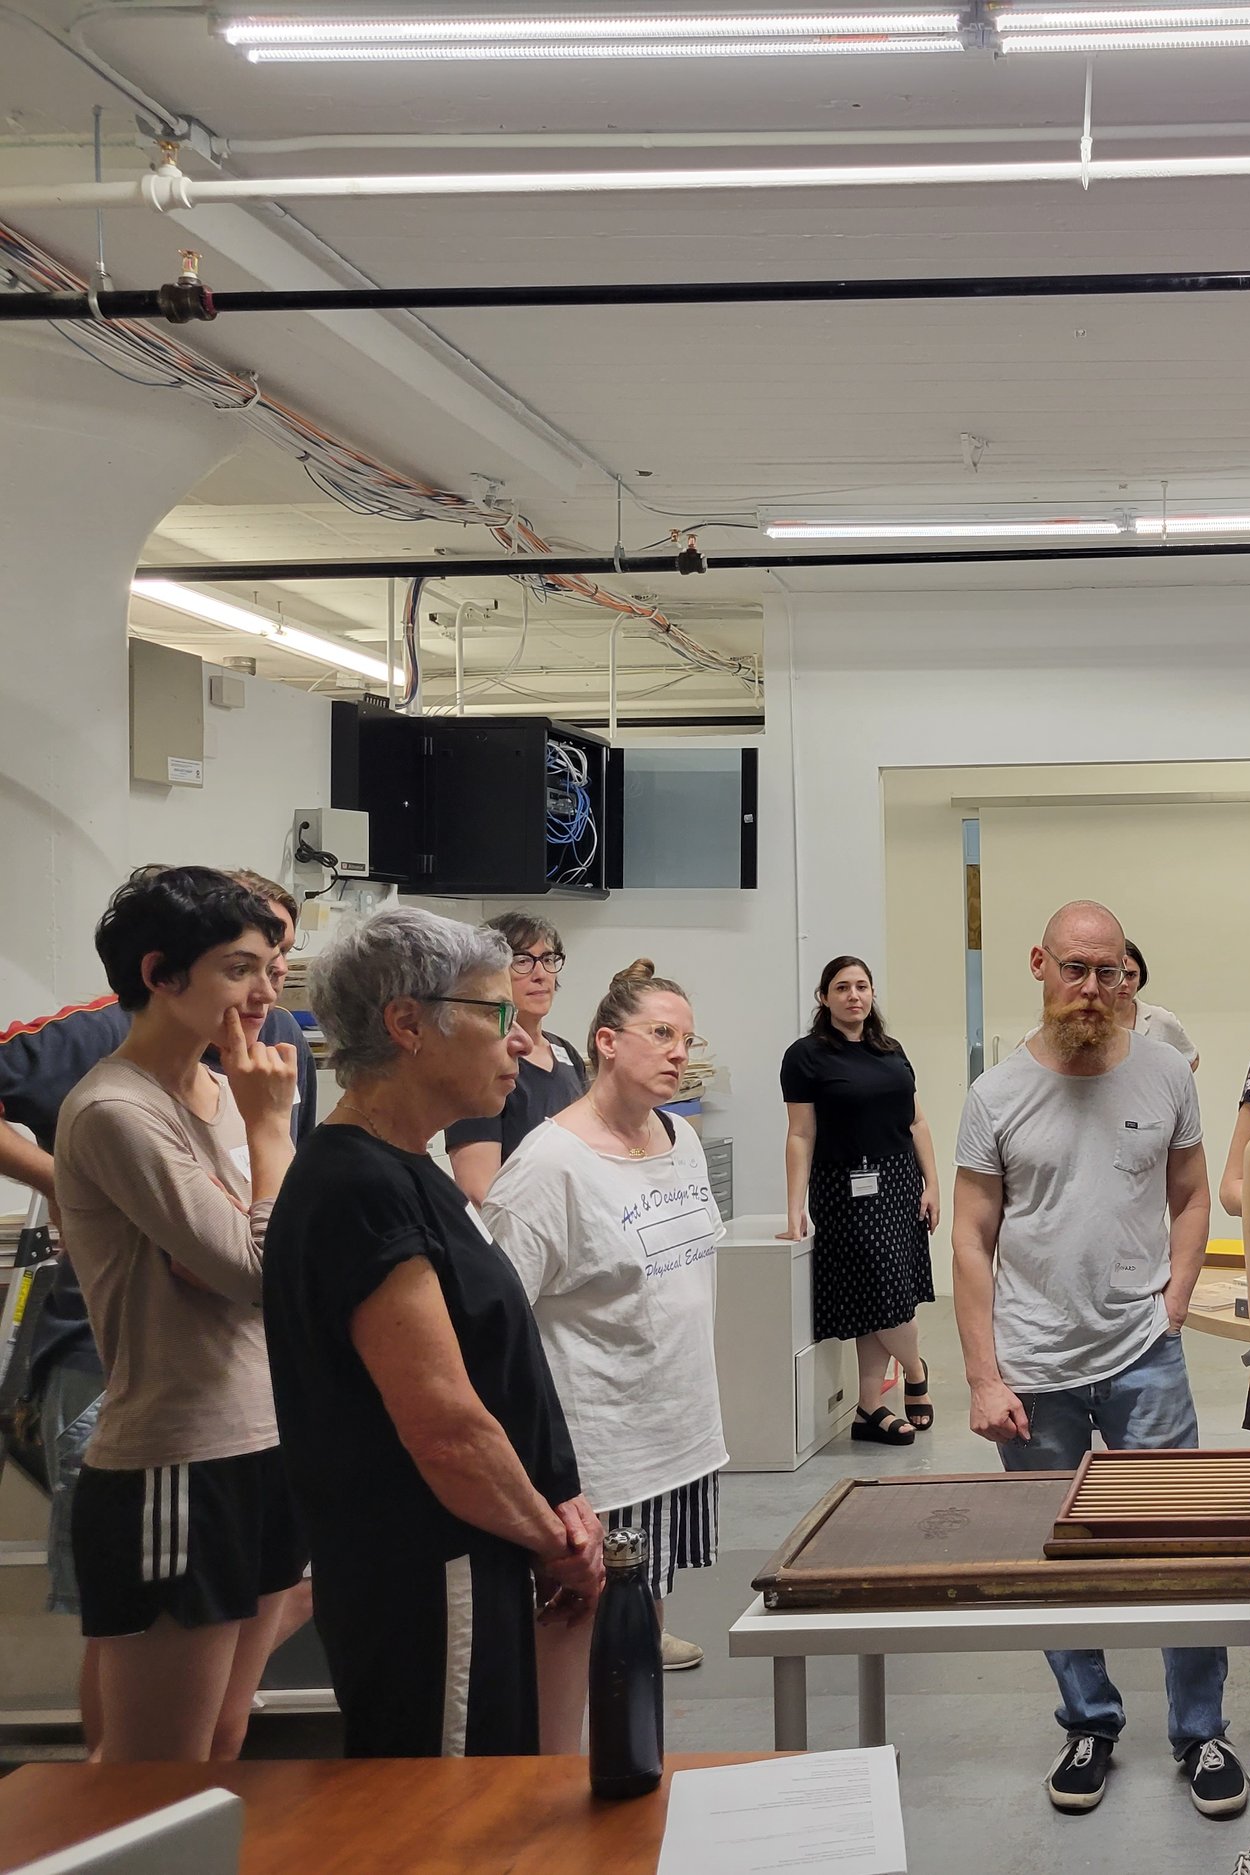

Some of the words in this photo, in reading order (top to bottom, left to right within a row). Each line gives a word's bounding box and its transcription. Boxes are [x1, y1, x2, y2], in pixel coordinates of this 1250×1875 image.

[621, 1204, 642, 1231] Art
[640, 1194, 651, 1211] &
[650, 1189, 690, 1208] Design
[645, 1255, 682, 1280] Physical
